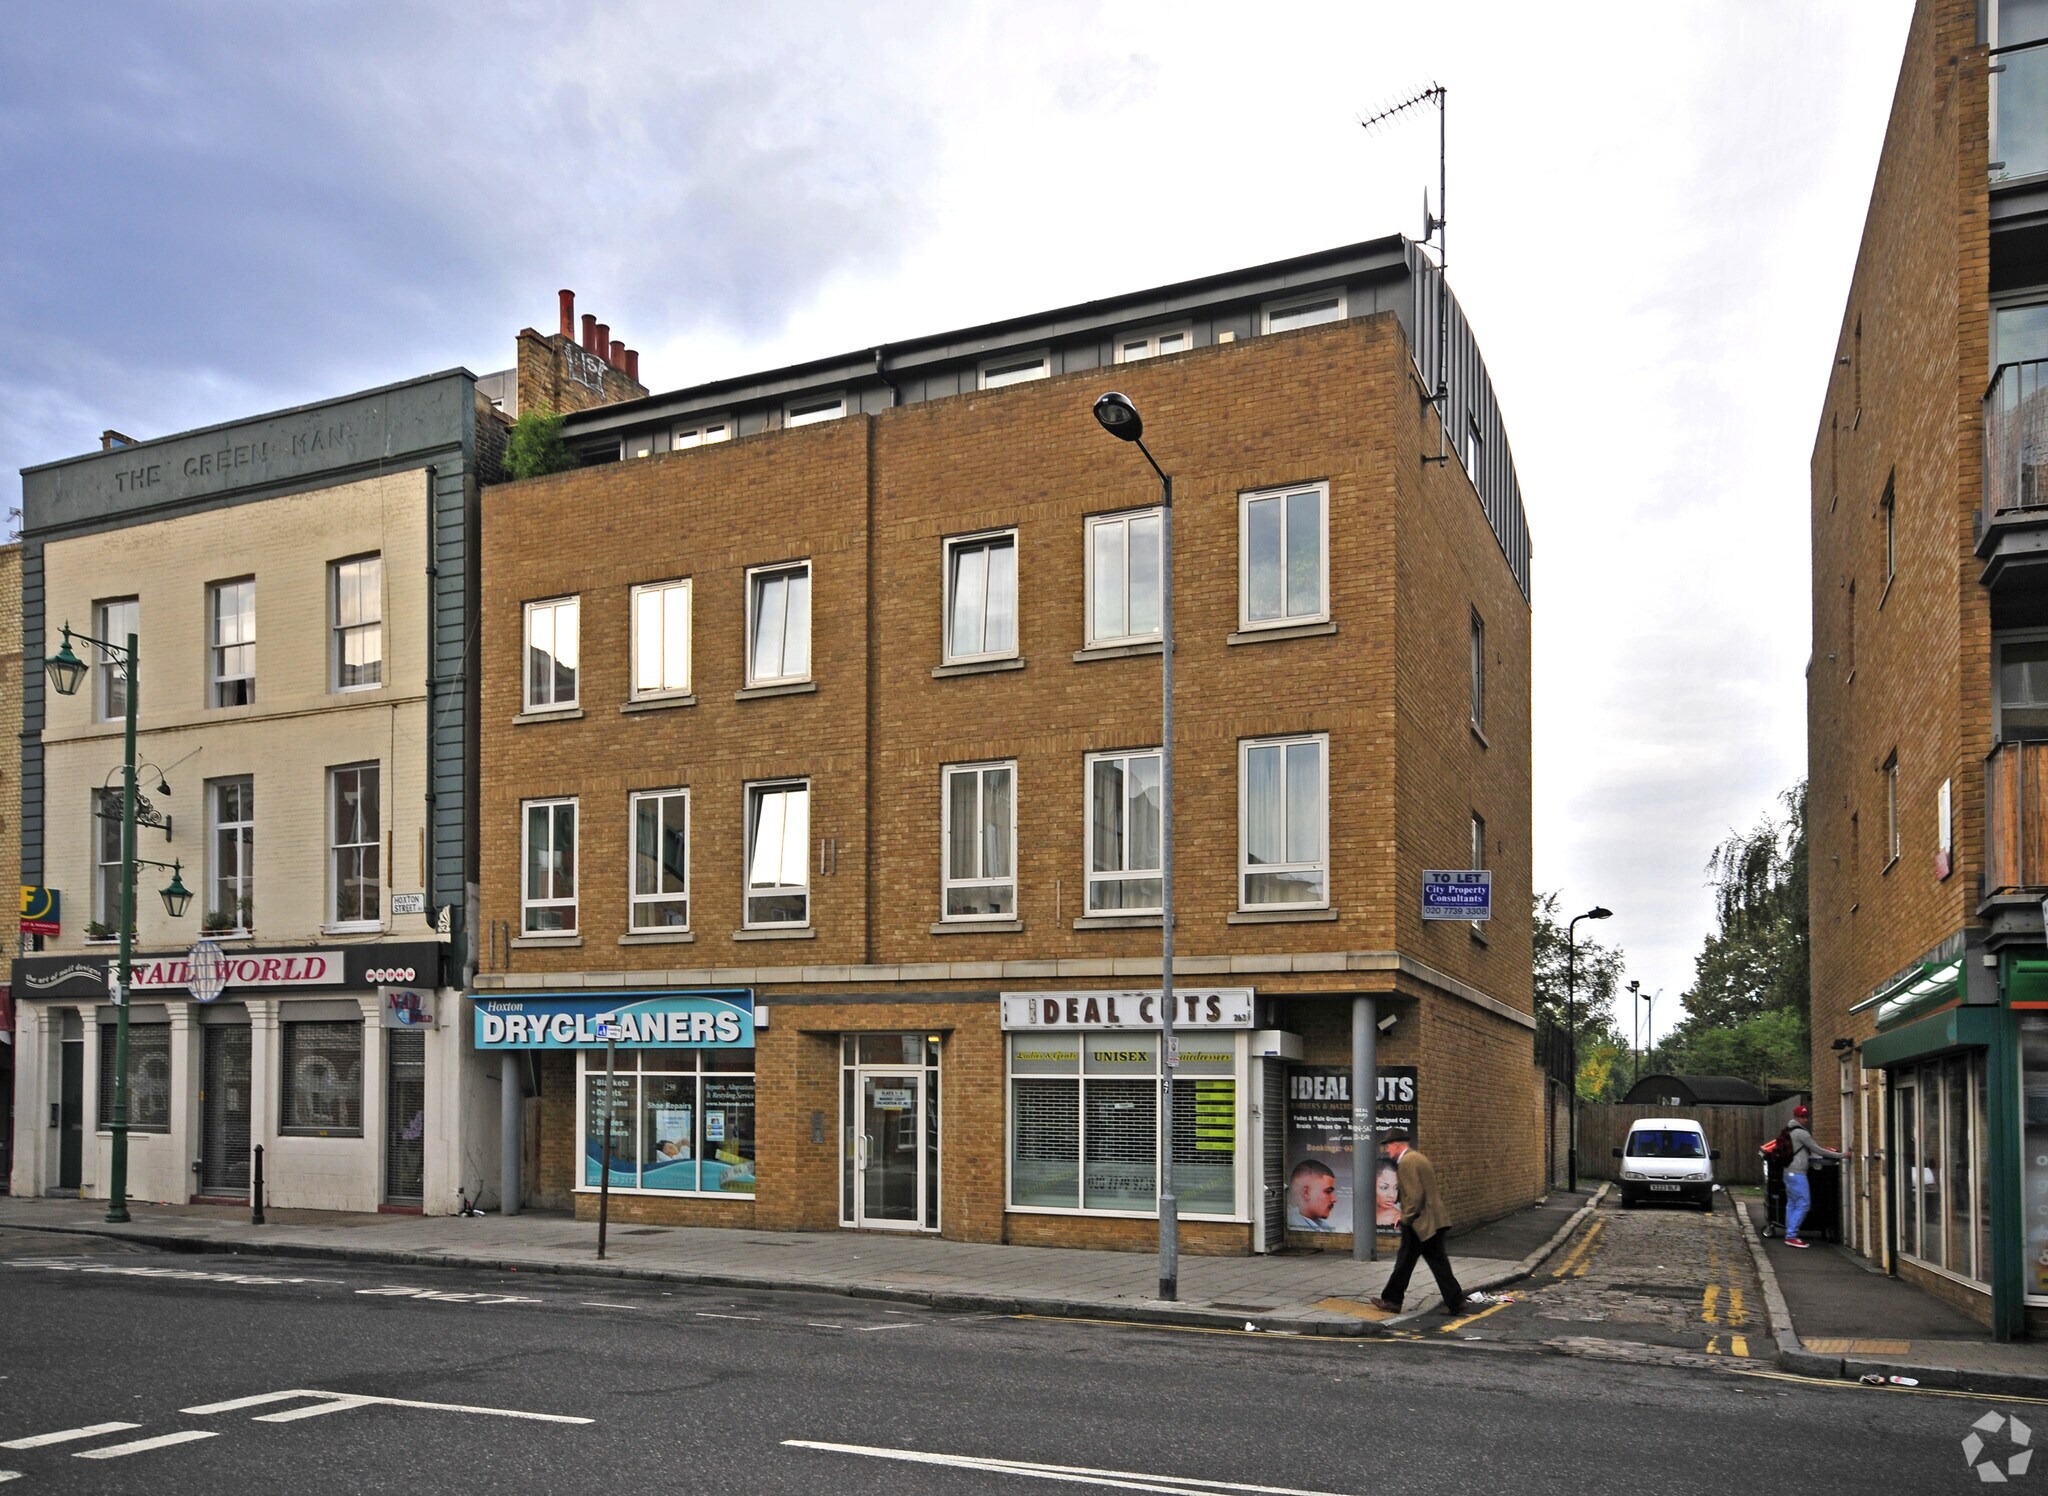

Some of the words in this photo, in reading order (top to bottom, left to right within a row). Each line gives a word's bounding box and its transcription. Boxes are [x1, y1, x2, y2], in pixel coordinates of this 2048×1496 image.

[115, 464, 161, 492] THE
[184, 441, 268, 478] GREEN
[292, 424, 350, 455] MAN
[1433, 874, 1451, 883] TO
[1457, 874, 1482, 883] LET
[1426, 885, 1445, 895] City
[1448, 885, 1487, 895] Property
[394, 896, 420, 904] HOXTON
[1430, 894, 1483, 903] Consultants
[394, 904, 416, 912] STREET
[26, 974, 37, 983] the
[50, 971, 58, 981] of
[60, 964, 74, 976] nail
[75, 963, 102, 976] designs
[129, 961, 196, 984] NAIL
[214, 957, 327, 983] WORLD
[487, 1001, 523, 1012] Hoxton
[1094, 1052, 1147, 1062] UNISEX
[1179, 1052, 1230, 1061] airdressers
[1291, 1076, 1349, 1100] IDEAL
[1376, 1077, 1414, 1102] UTS
[596, 1099, 628, 1107] Cuains
[666, 1102, 692, 1111] Repairs
[1386, 1104, 1414, 1112] STUDIO
